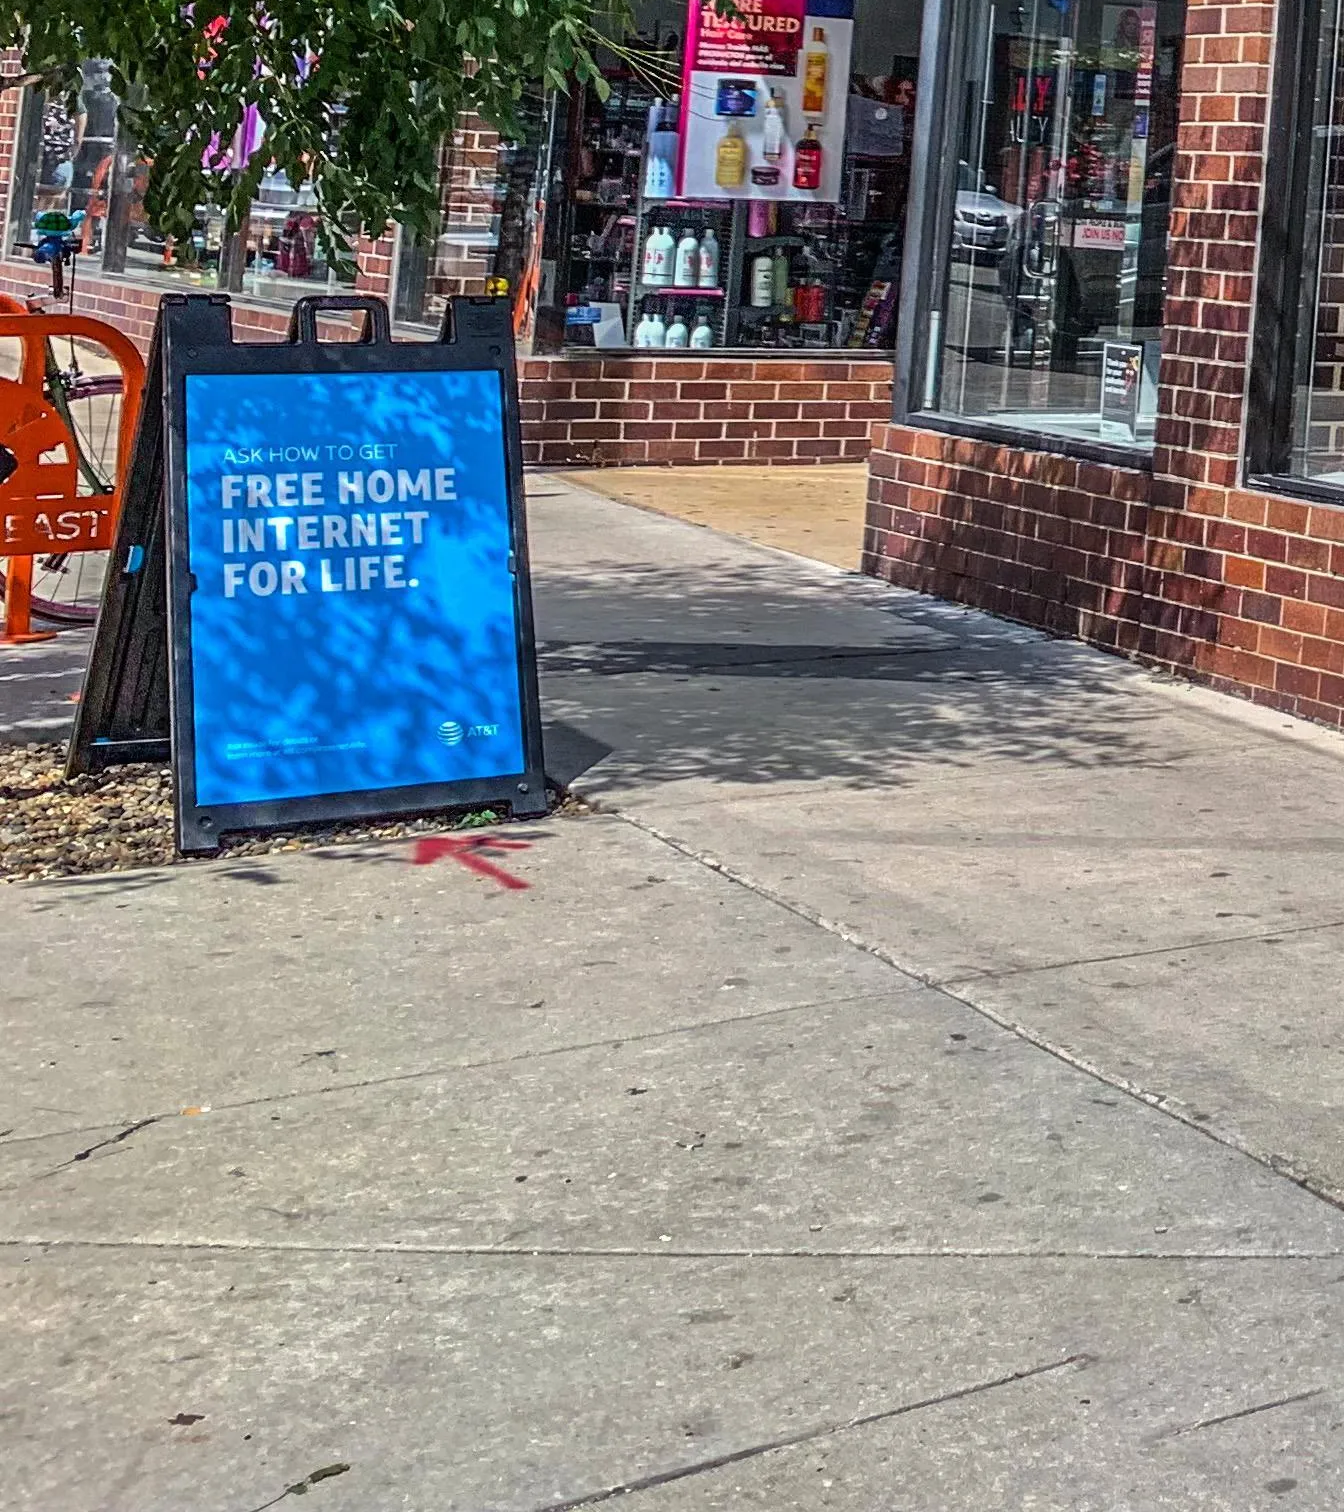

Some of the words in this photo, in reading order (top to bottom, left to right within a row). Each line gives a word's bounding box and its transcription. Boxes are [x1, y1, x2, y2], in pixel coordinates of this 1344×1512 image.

[223, 447, 264, 464] ASK
[269, 445, 320, 463] HOW
[325, 444, 353, 461] TO
[359, 443, 398, 460] GET
[221, 471, 325, 509] FREE
[338, 467, 457, 505] HOME
[4, 509, 109, 544] EAST
[222, 510, 430, 554] INTERNET
[223, 559, 308, 598] FOR
[320, 554, 420, 592] LIFE.
[467, 723, 499, 740] AT&T
